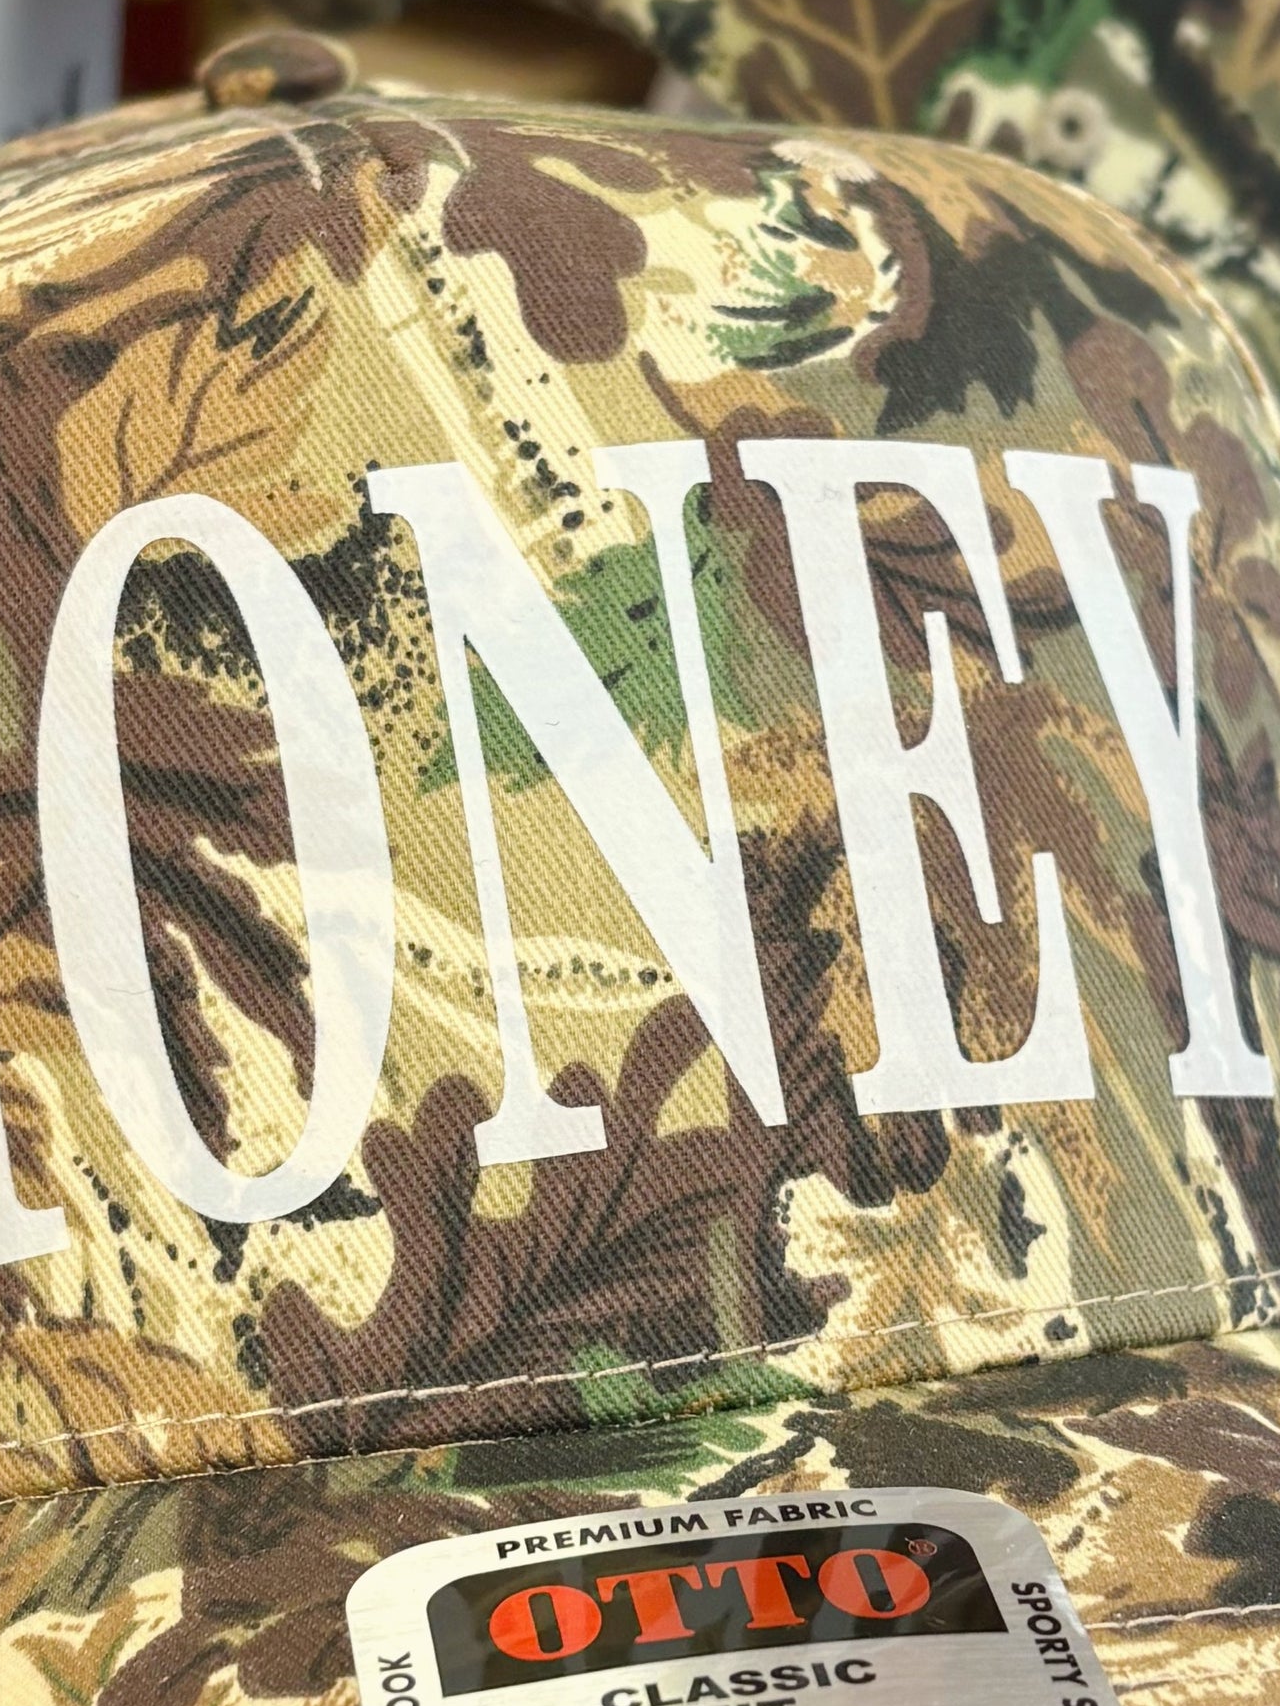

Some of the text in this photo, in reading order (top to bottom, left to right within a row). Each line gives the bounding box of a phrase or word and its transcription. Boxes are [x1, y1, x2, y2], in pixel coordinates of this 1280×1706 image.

[495, 1498, 879, 1560] PREMIUM FABRIC
[489, 1548, 930, 1661] OTTO
[1011, 1581, 1089, 1688] SPORTY
